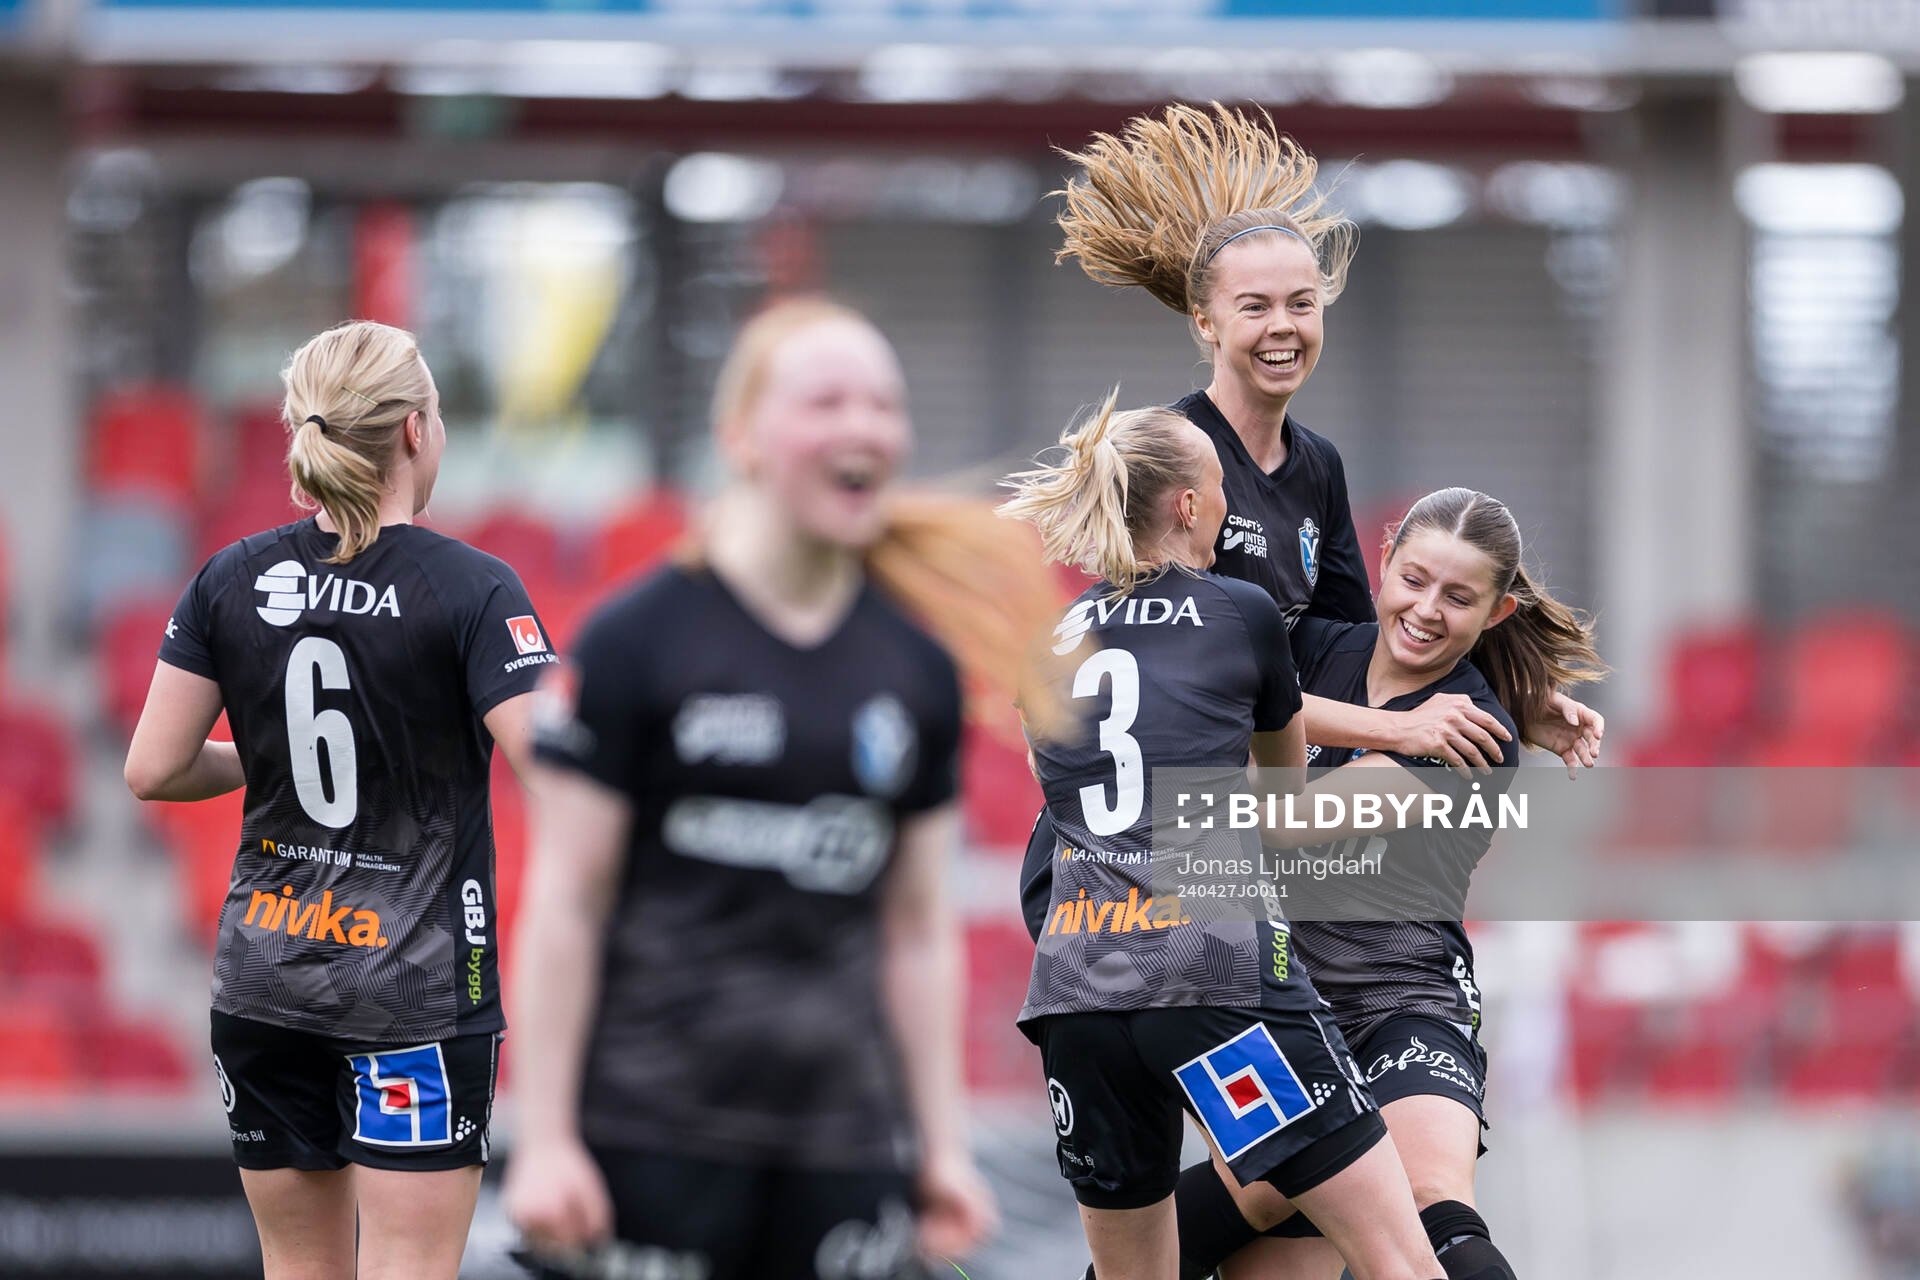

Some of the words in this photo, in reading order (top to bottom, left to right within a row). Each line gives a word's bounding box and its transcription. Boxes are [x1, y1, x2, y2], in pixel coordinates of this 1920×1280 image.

[1228, 514, 1257, 531] CRAFT
[1244, 530, 1267, 548] INTER
[1244, 542, 1267, 559] SPORT
[308, 573, 401, 617] VIDA
[1096, 595, 1204, 627] VIDA
[504, 654, 547, 673] SVENSKA
[285, 636, 358, 829] 6
[1072, 648, 1144, 836] 3
[277, 843, 352, 868] GARANTUM
[356, 853, 383, 862] WEALTH
[355, 860, 401, 873] MANAGEMENT
[461, 879, 487, 945] GBJ
[249, 1129, 266, 1142] Bil
